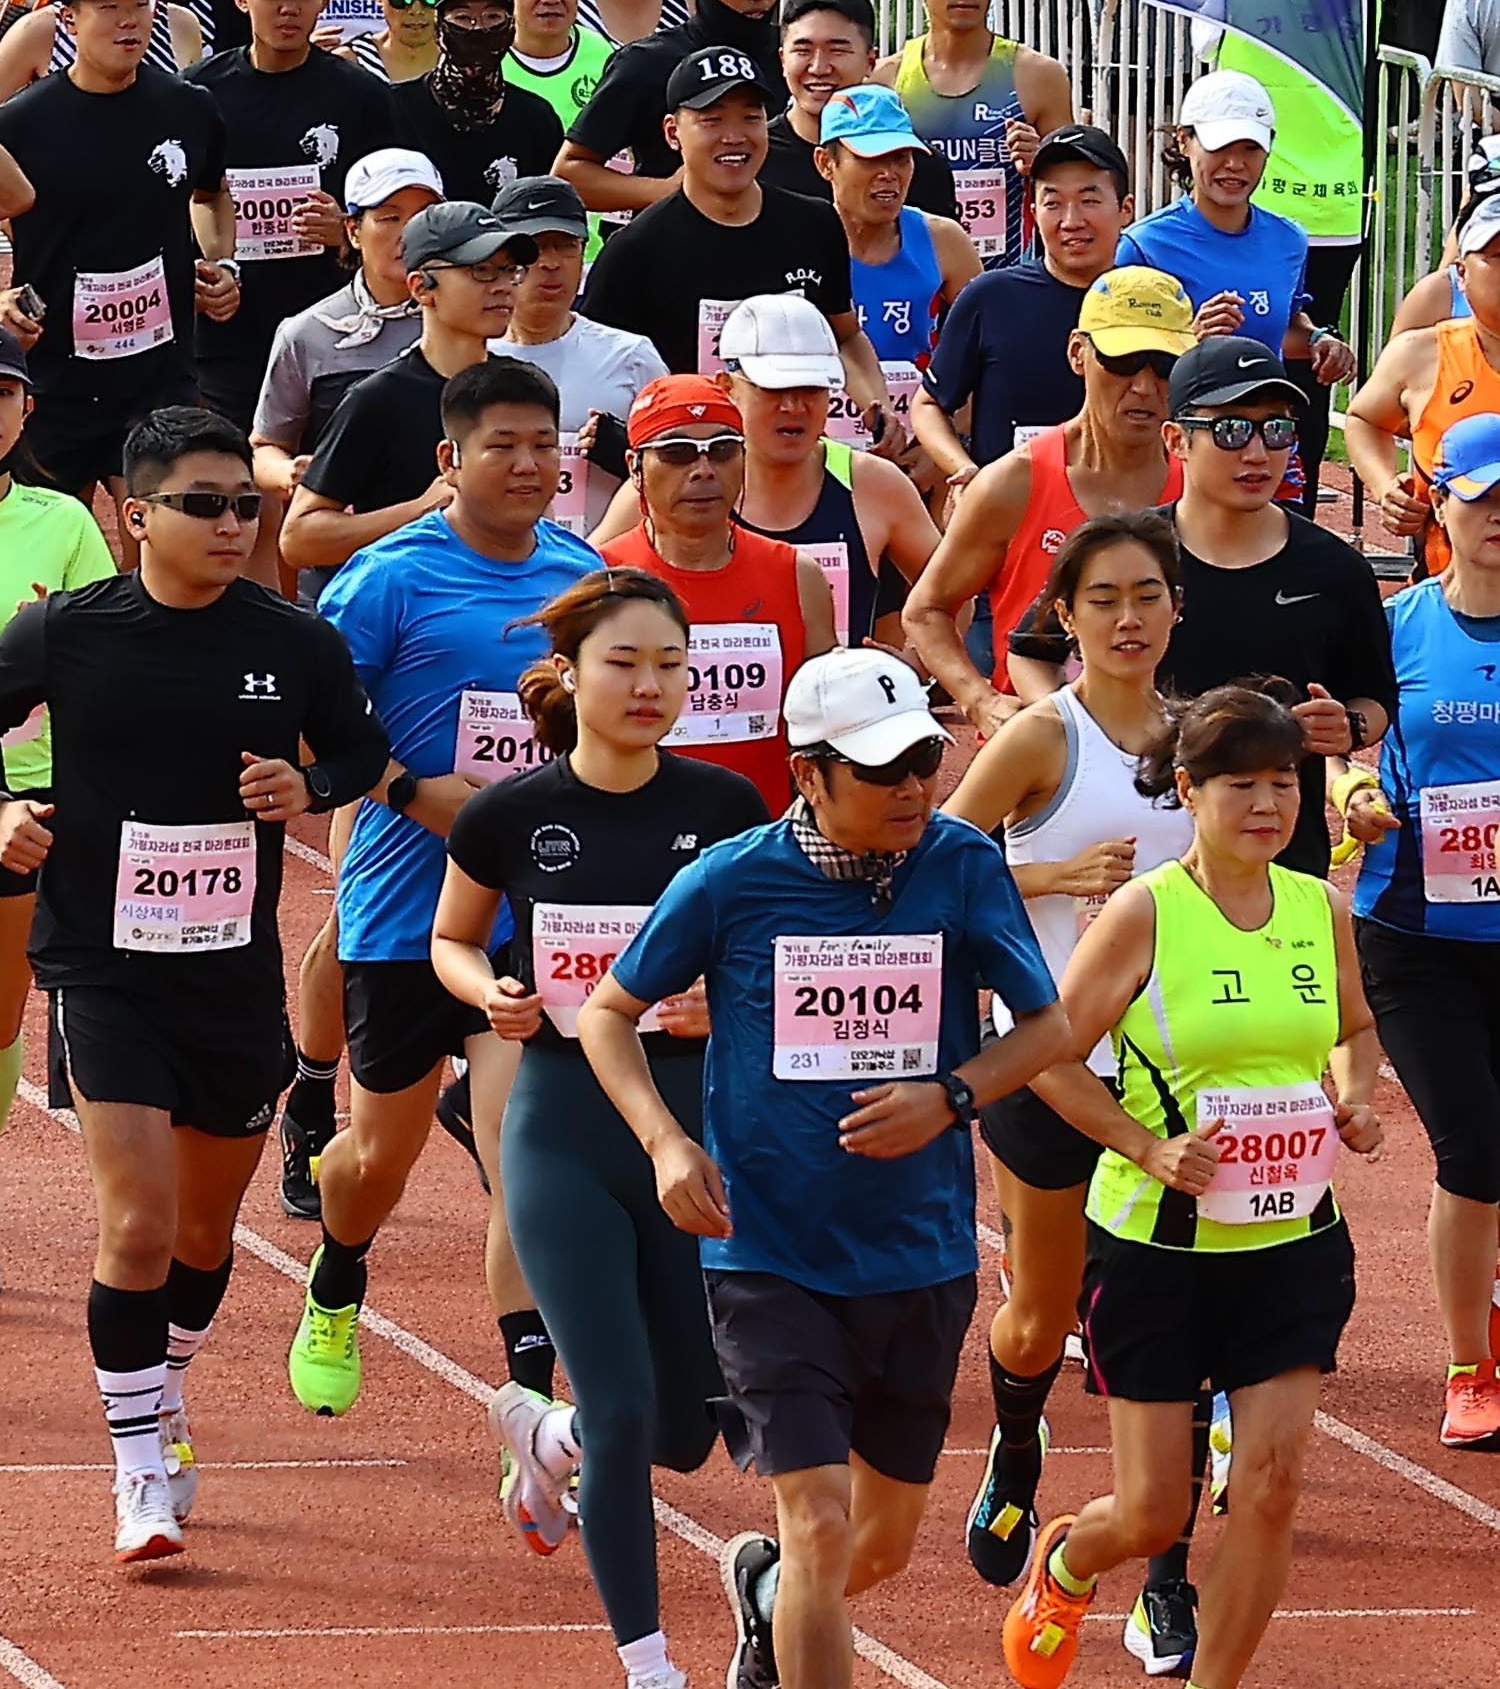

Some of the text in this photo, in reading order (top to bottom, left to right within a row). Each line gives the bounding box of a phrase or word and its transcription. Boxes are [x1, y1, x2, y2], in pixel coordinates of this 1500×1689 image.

[697, 54, 756, 81] 188
[84, 288, 162, 330] 20004
[722, 636, 772, 648] 마라톤대회
[686, 663, 767, 693] 0109
[877, 674, 897, 705] P
[690, 691, 739, 715] 남충식
[128, 836, 250, 854] 가평자라섬 전국 마라톤대회
[133, 866, 242, 897] 20178
[541, 919, 622, 935] 가평자라섬 전국
[784, 950, 934, 967] 가평자라섬 전국 마라톤대회
[794, 983, 923, 1017] 20104
[833, 1018, 889, 1040] 김정식
[790, 1052, 820, 1070] 231
[1218, 1127, 1327, 1164] 28007
[1249, 1162, 1299, 1186] 신철옥
[1249, 1191, 1295, 1218] 1AB
